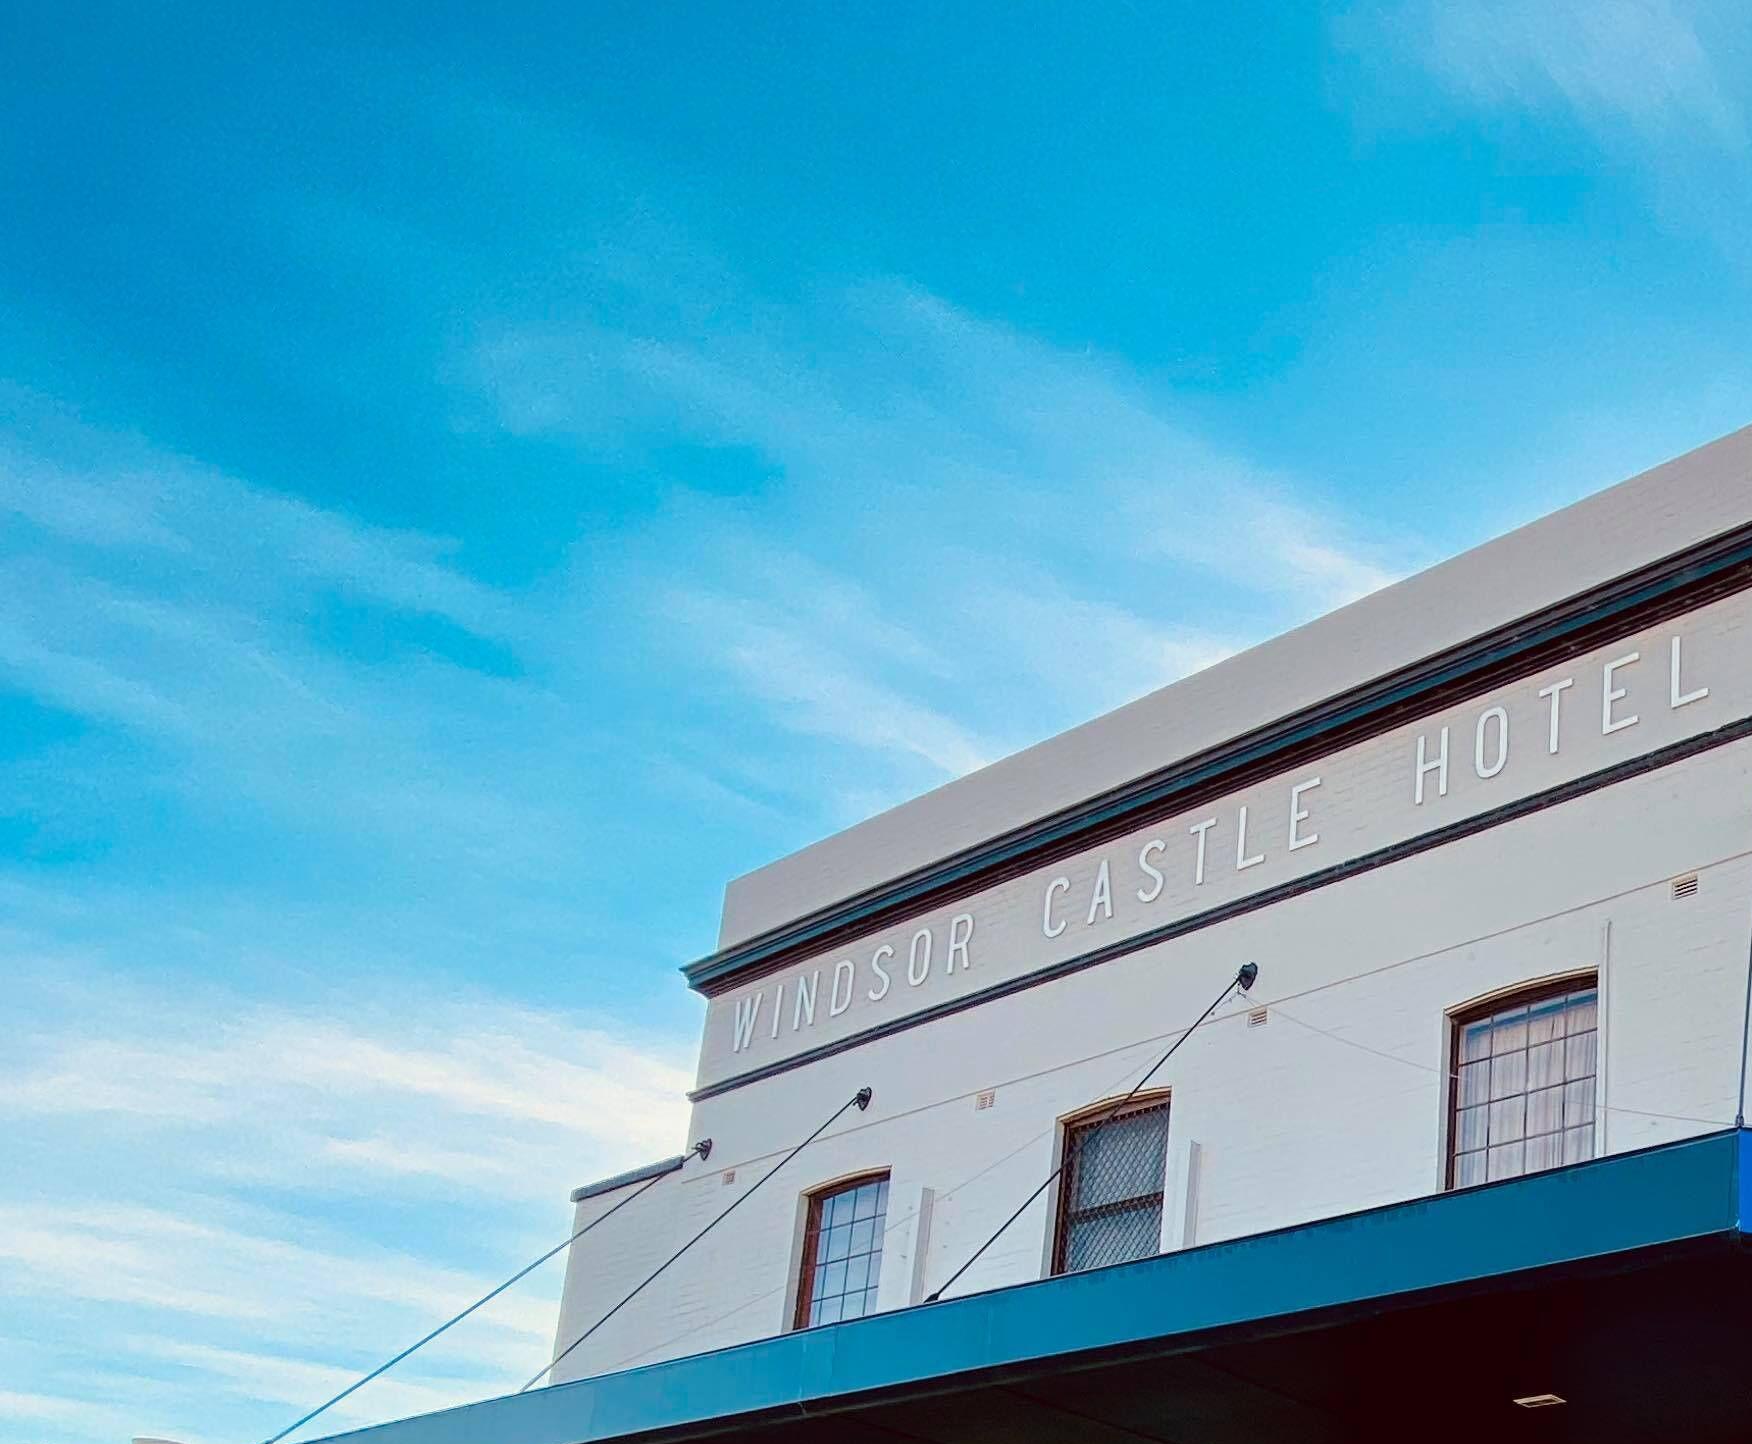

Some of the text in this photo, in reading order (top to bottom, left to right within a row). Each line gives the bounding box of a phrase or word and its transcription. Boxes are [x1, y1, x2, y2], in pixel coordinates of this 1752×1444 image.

[733, 636, 1710, 1053] WINDSOR CASTLE HOTEL
